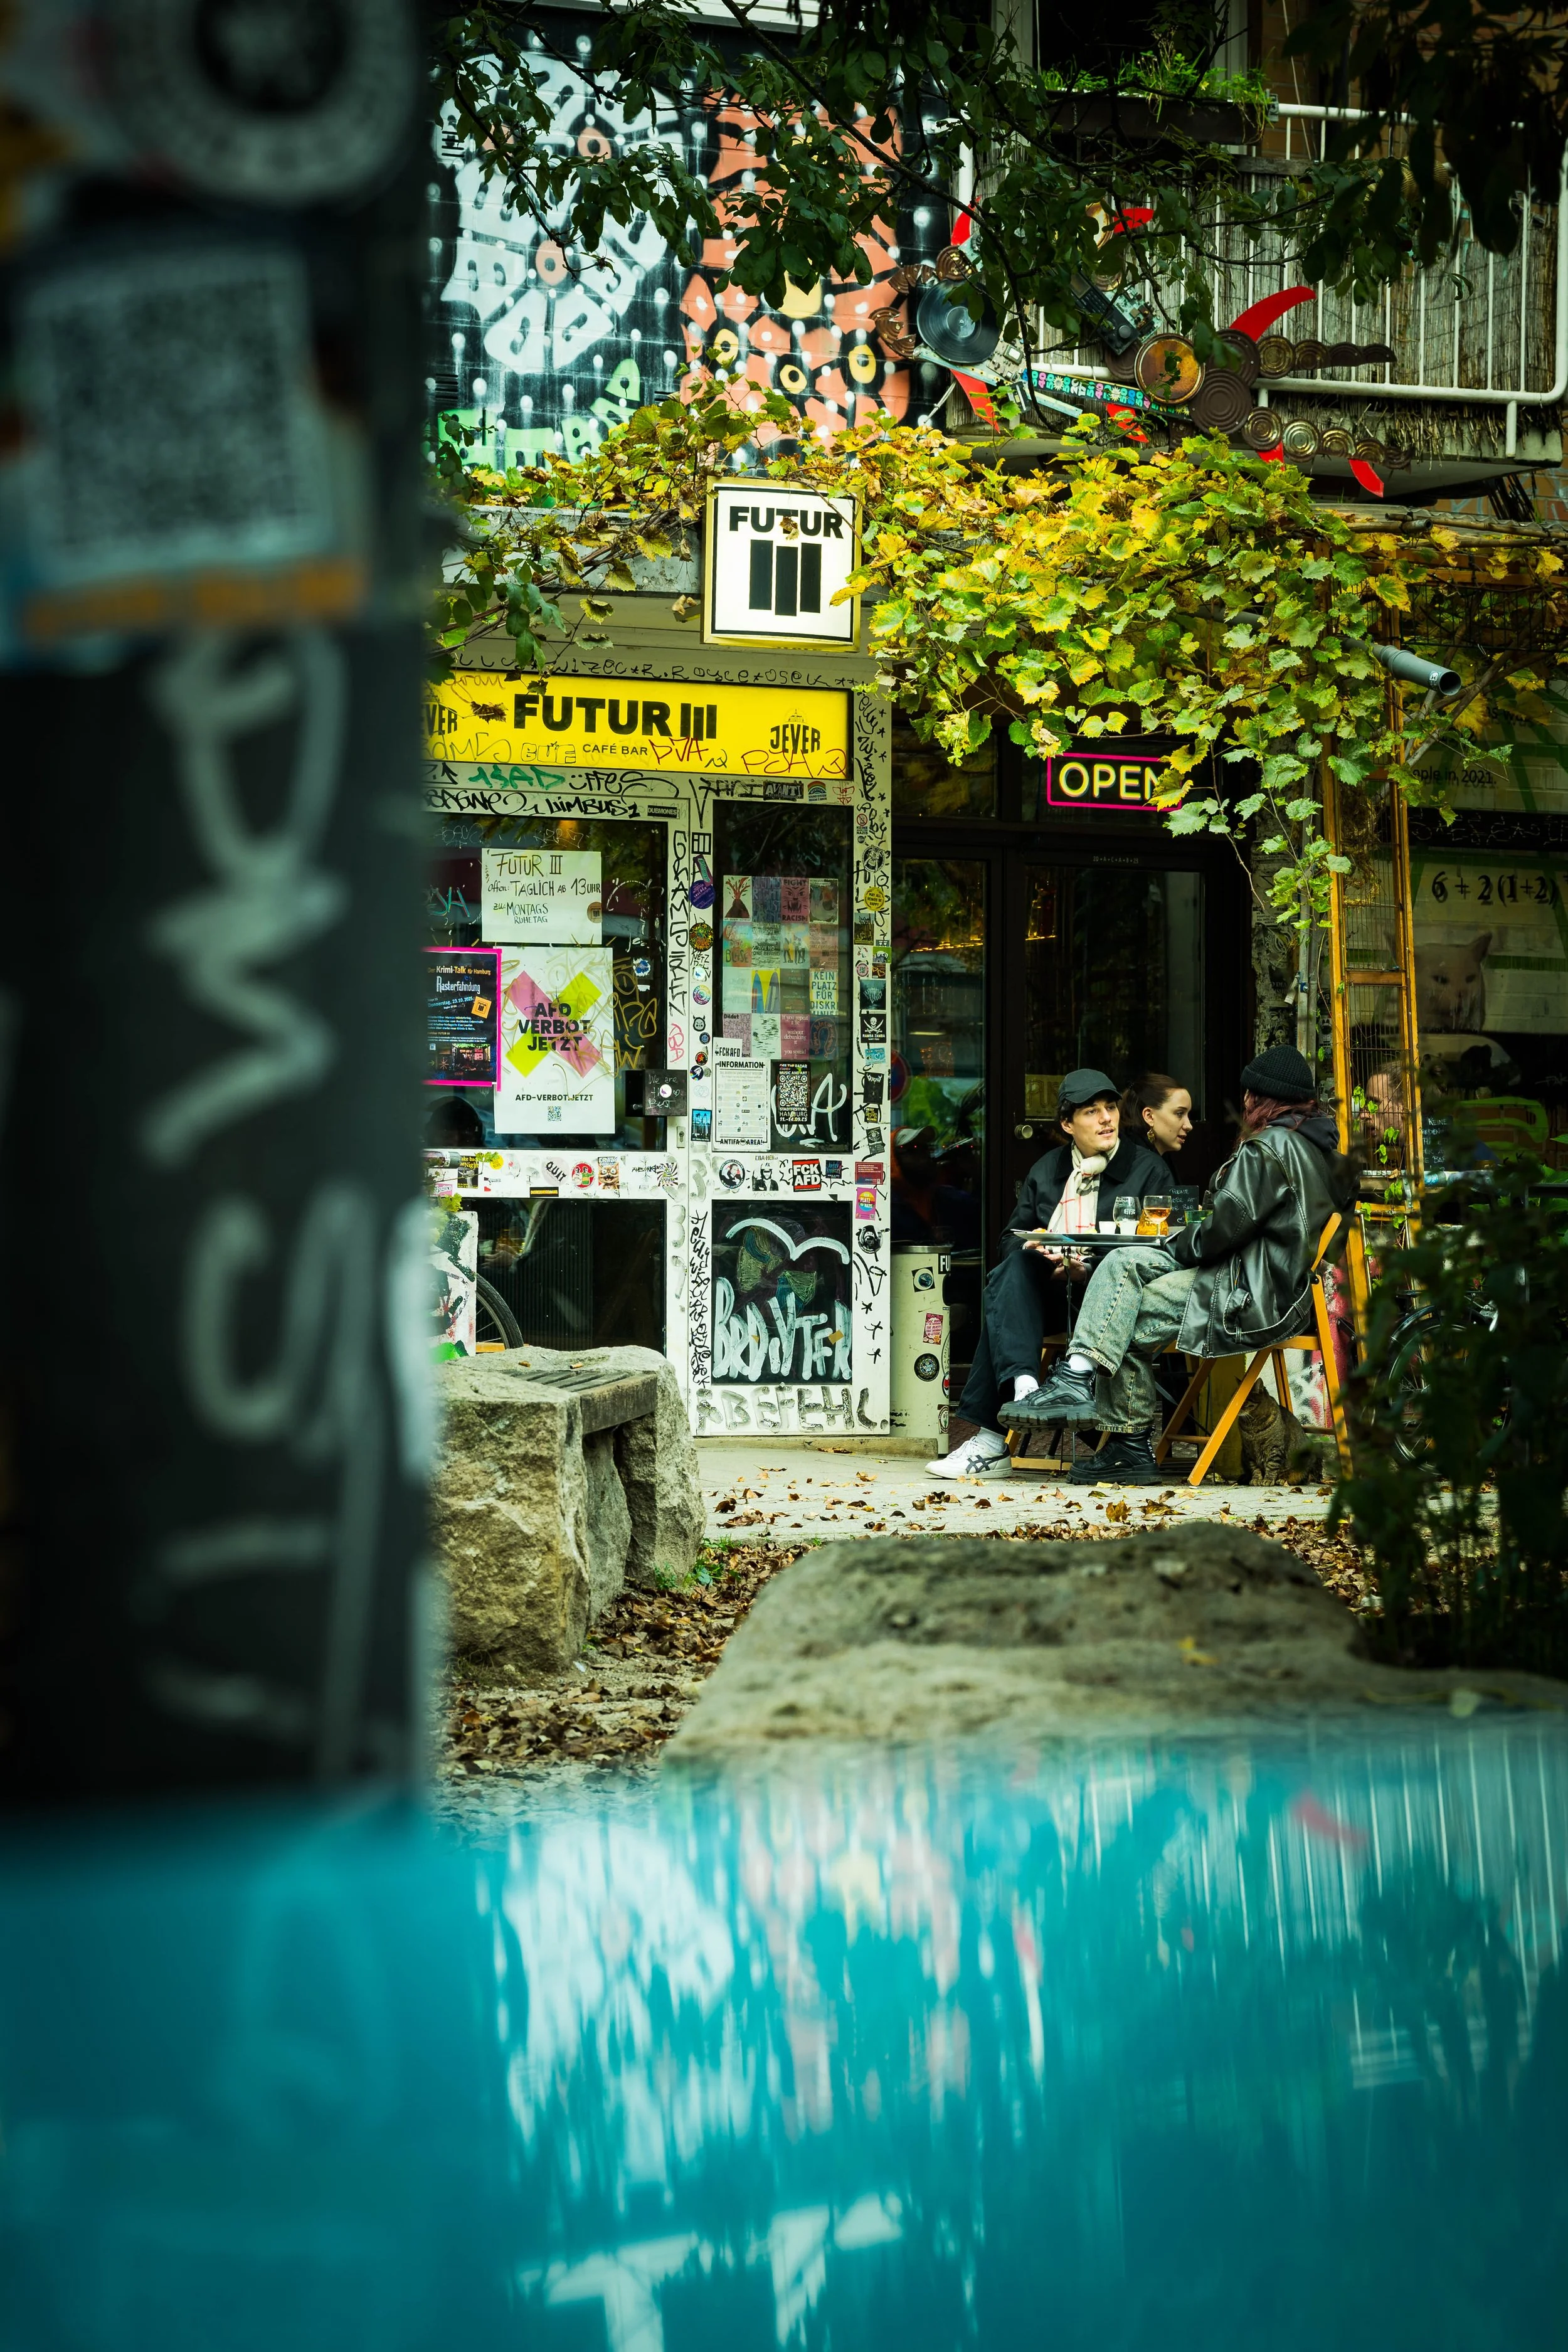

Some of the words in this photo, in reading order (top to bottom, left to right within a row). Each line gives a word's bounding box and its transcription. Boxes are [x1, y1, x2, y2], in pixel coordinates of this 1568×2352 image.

[729, 506, 844, 539] FUTUR
[748, 539, 822, 617] III
[513, 692, 672, 738] FUTUR
[679, 702, 718, 742] III
[770, 723, 822, 755] JEVER
[582, 742, 617, 755] CAFÉ
[621, 744, 649, 756] BAR
[1461, 768, 1498, 787] 2021.
[765, 782, 803, 797] AVANTI
[491, 852, 544, 877] FUTUR
[549, 855, 563, 875] III
[557, 884, 566, 894] AB
[570, 877, 586, 896] 13
[586, 883, 601, 894] UHR
[506, 901, 549, 916] MONTAGS
[436, 965, 466, 974] Krimi-Talk
[813, 972, 835, 980] KEIN
[436, 975, 480, 995] Rasterfahndung
[812, 981, 837, 990] PLATZ
[816, 988, 833, 1000] FÜR
[534, 1002, 572, 1018] AFD
[518, 1019, 591, 1034] VERBOT
[527, 1036, 583, 1052] JETZT
[719, 1061, 764, 1069] INFORMATION
[515, 1094, 594, 1102] AFD-VERBOT.JETZT
[746, 1138, 763, 1147] AREA!
[545, 1160, 568, 1182] QUIT
[794, 1164, 818, 1177] FCK
[794, 1175, 822, 1187] AFD
